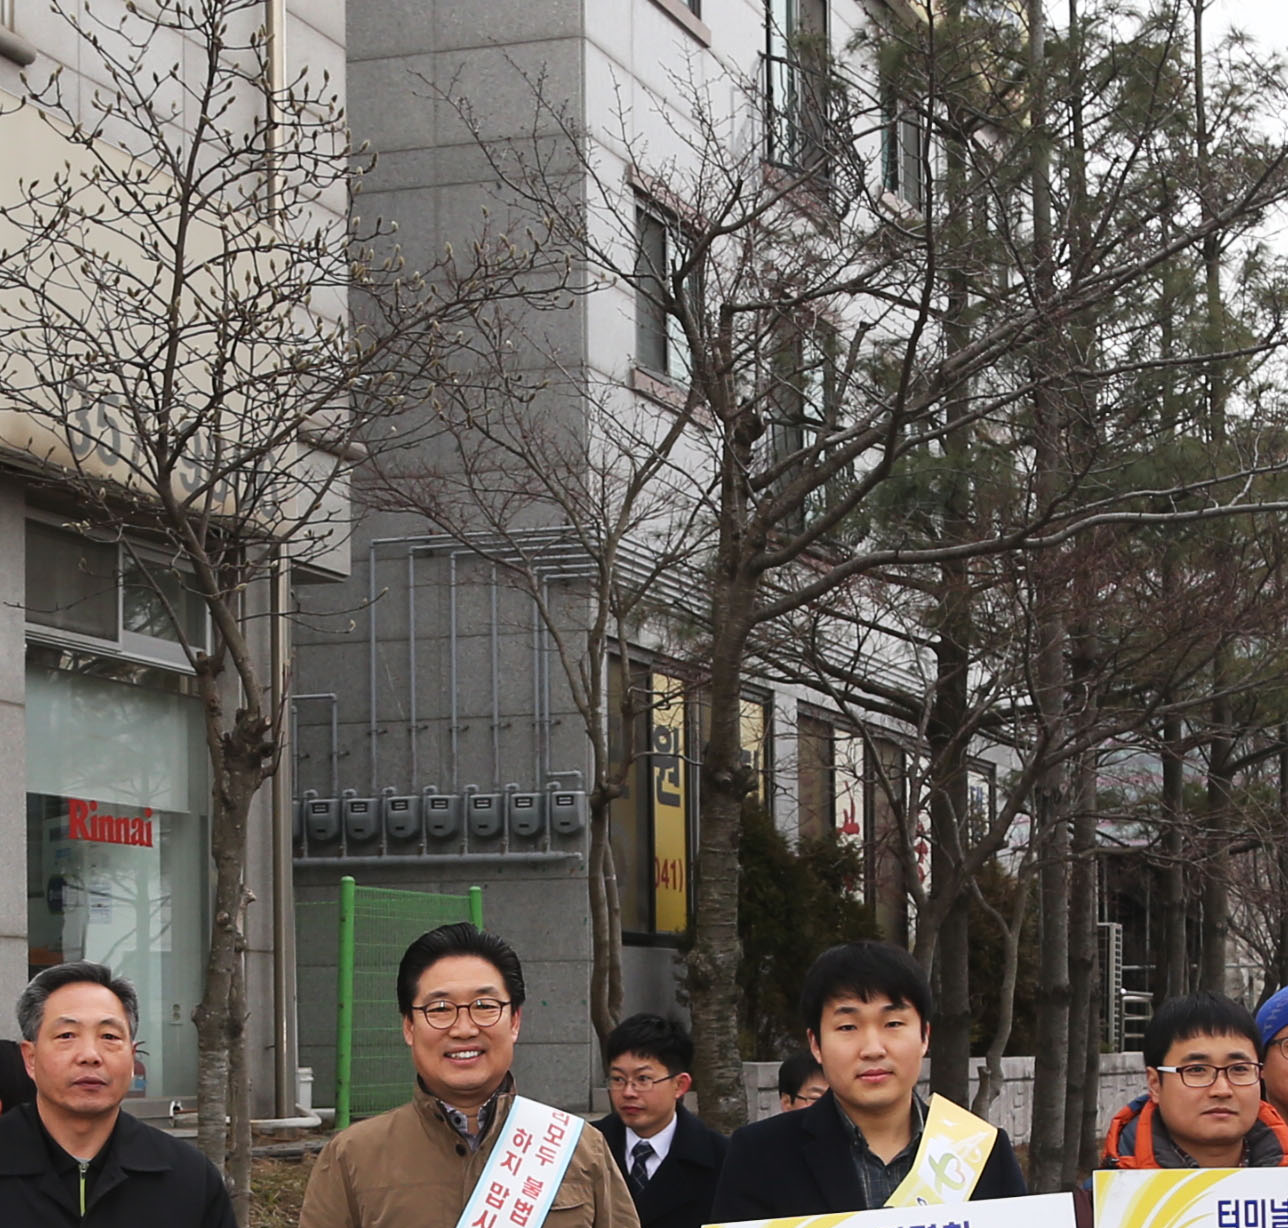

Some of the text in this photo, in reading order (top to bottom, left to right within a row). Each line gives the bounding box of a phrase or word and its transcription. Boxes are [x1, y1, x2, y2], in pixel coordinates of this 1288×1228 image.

[67, 798, 154, 848] Rinnai
[498, 1127, 533, 1177] 하지
[509, 1175, 545, 1228] 불법
